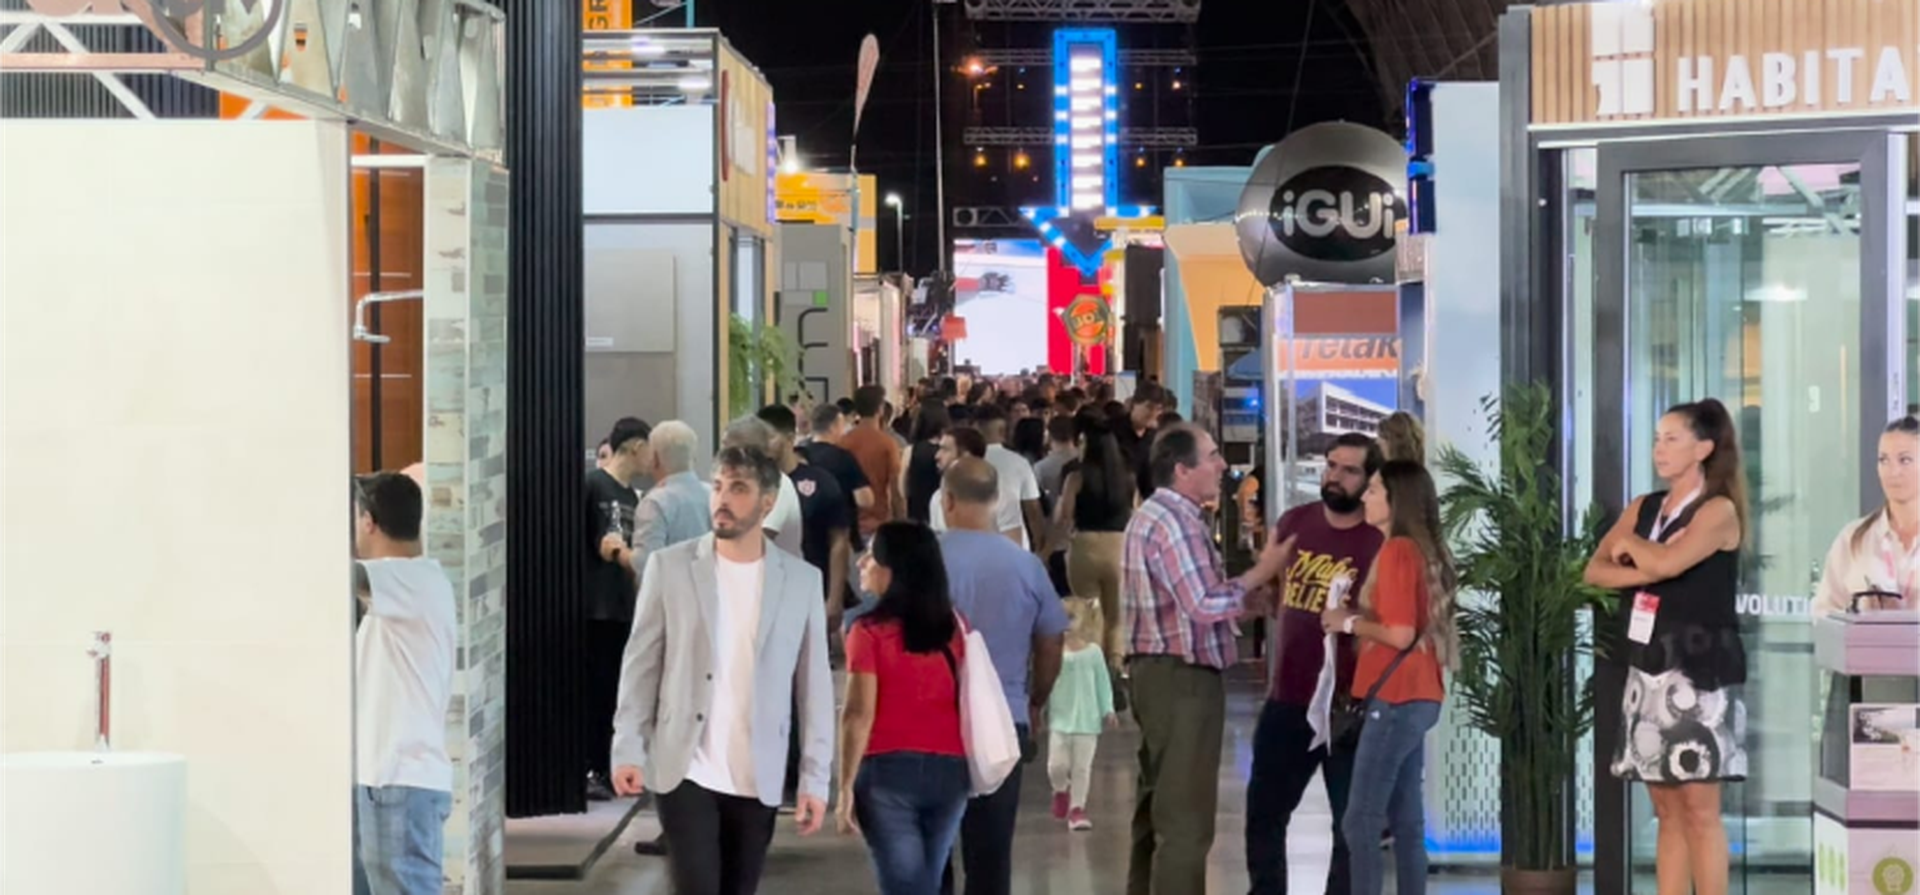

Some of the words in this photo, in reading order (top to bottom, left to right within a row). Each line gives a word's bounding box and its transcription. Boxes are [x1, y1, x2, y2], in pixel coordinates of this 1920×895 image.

[1677, 45, 1920, 112] HABITA
[1283, 189, 1395, 239] iGUi
[1735, 593, 1816, 616] VOLUTI
